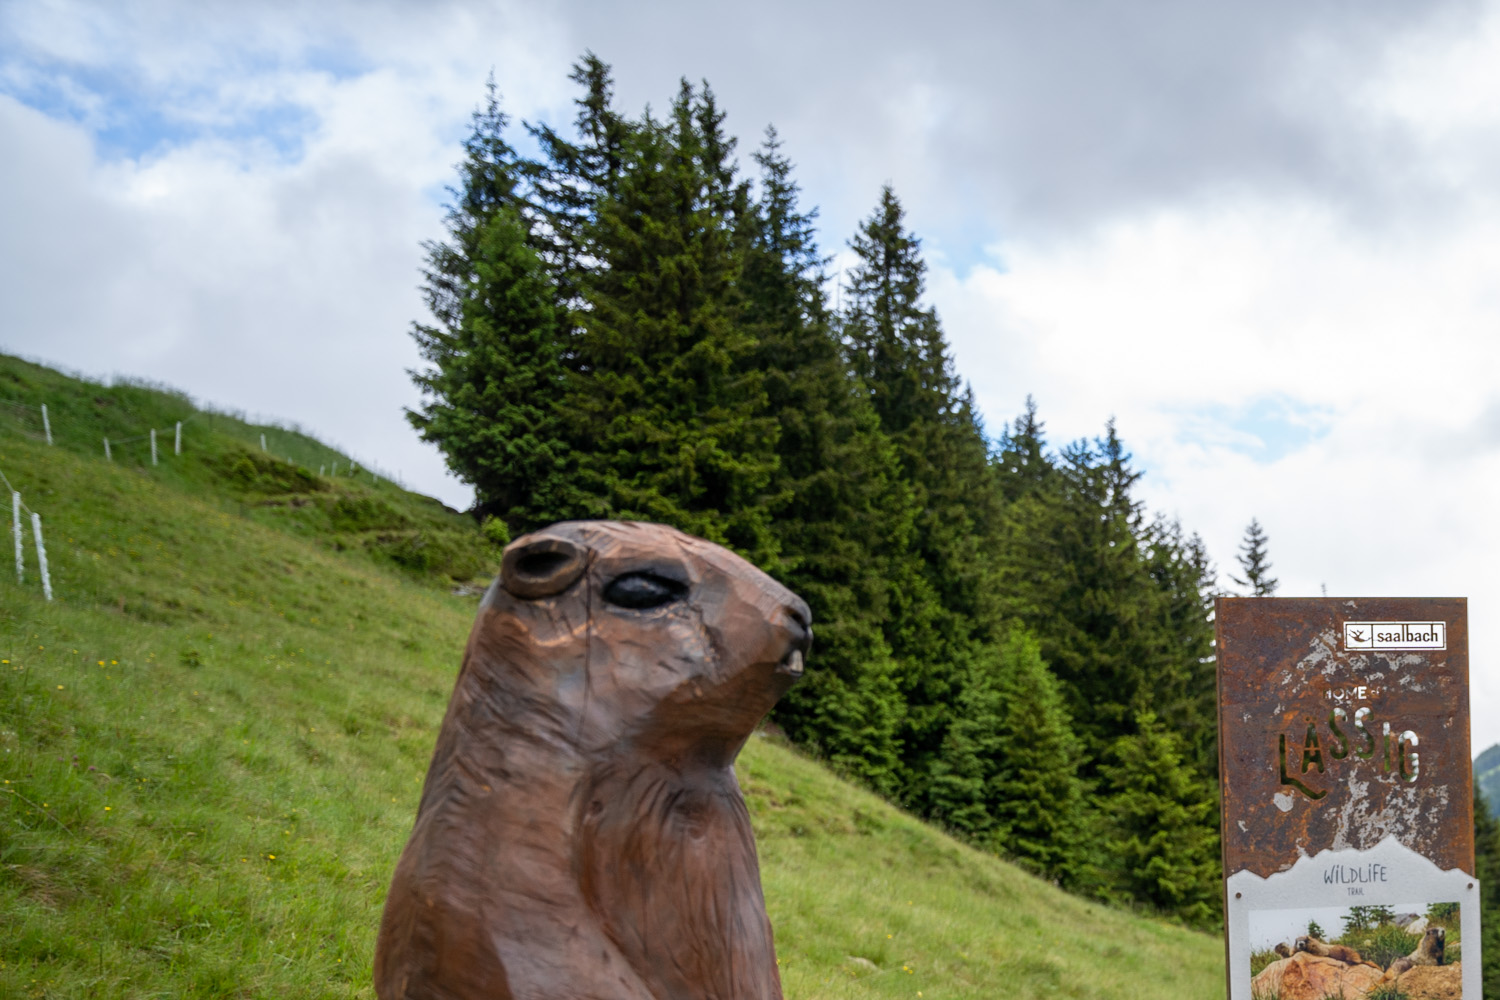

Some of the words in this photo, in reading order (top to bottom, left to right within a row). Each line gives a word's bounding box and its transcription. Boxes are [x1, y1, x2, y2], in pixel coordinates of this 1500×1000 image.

[1377, 624, 1439, 643] saalbach
[1322, 686, 1368, 700] HOME
[1279, 707, 1419, 800] LÄSSIG
